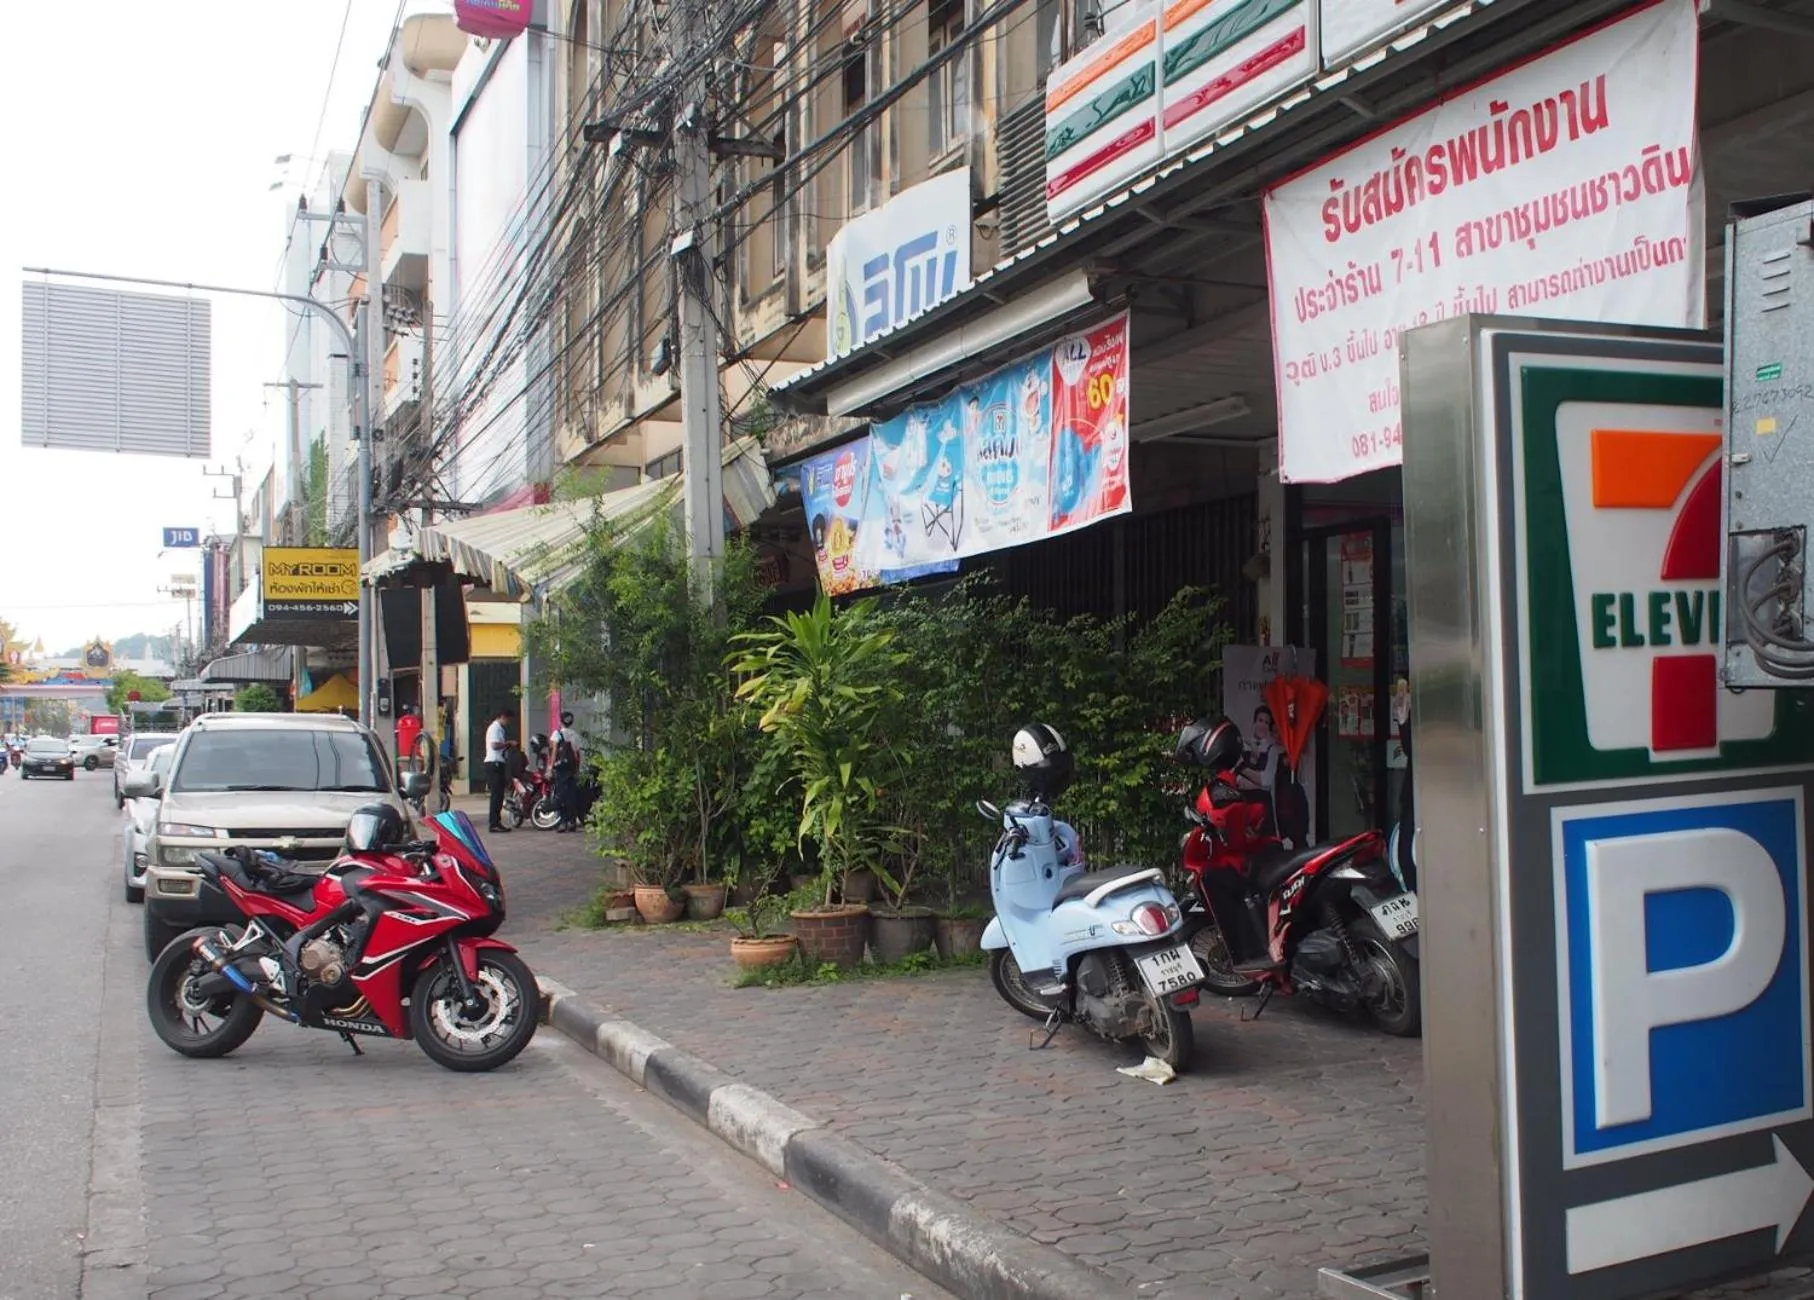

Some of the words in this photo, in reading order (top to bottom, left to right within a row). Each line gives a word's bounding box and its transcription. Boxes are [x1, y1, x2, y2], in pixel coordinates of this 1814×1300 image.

[1321, 74, 1609, 243] รับสมัครพนักงาน
[1391, 231, 1442, 284] 7-11
[1088, 373, 1115, 410] 60
[1157, 971, 1196, 992] 7580
[1586, 828, 1786, 1130] P
[322, 1017, 386, 1034] HONDA
